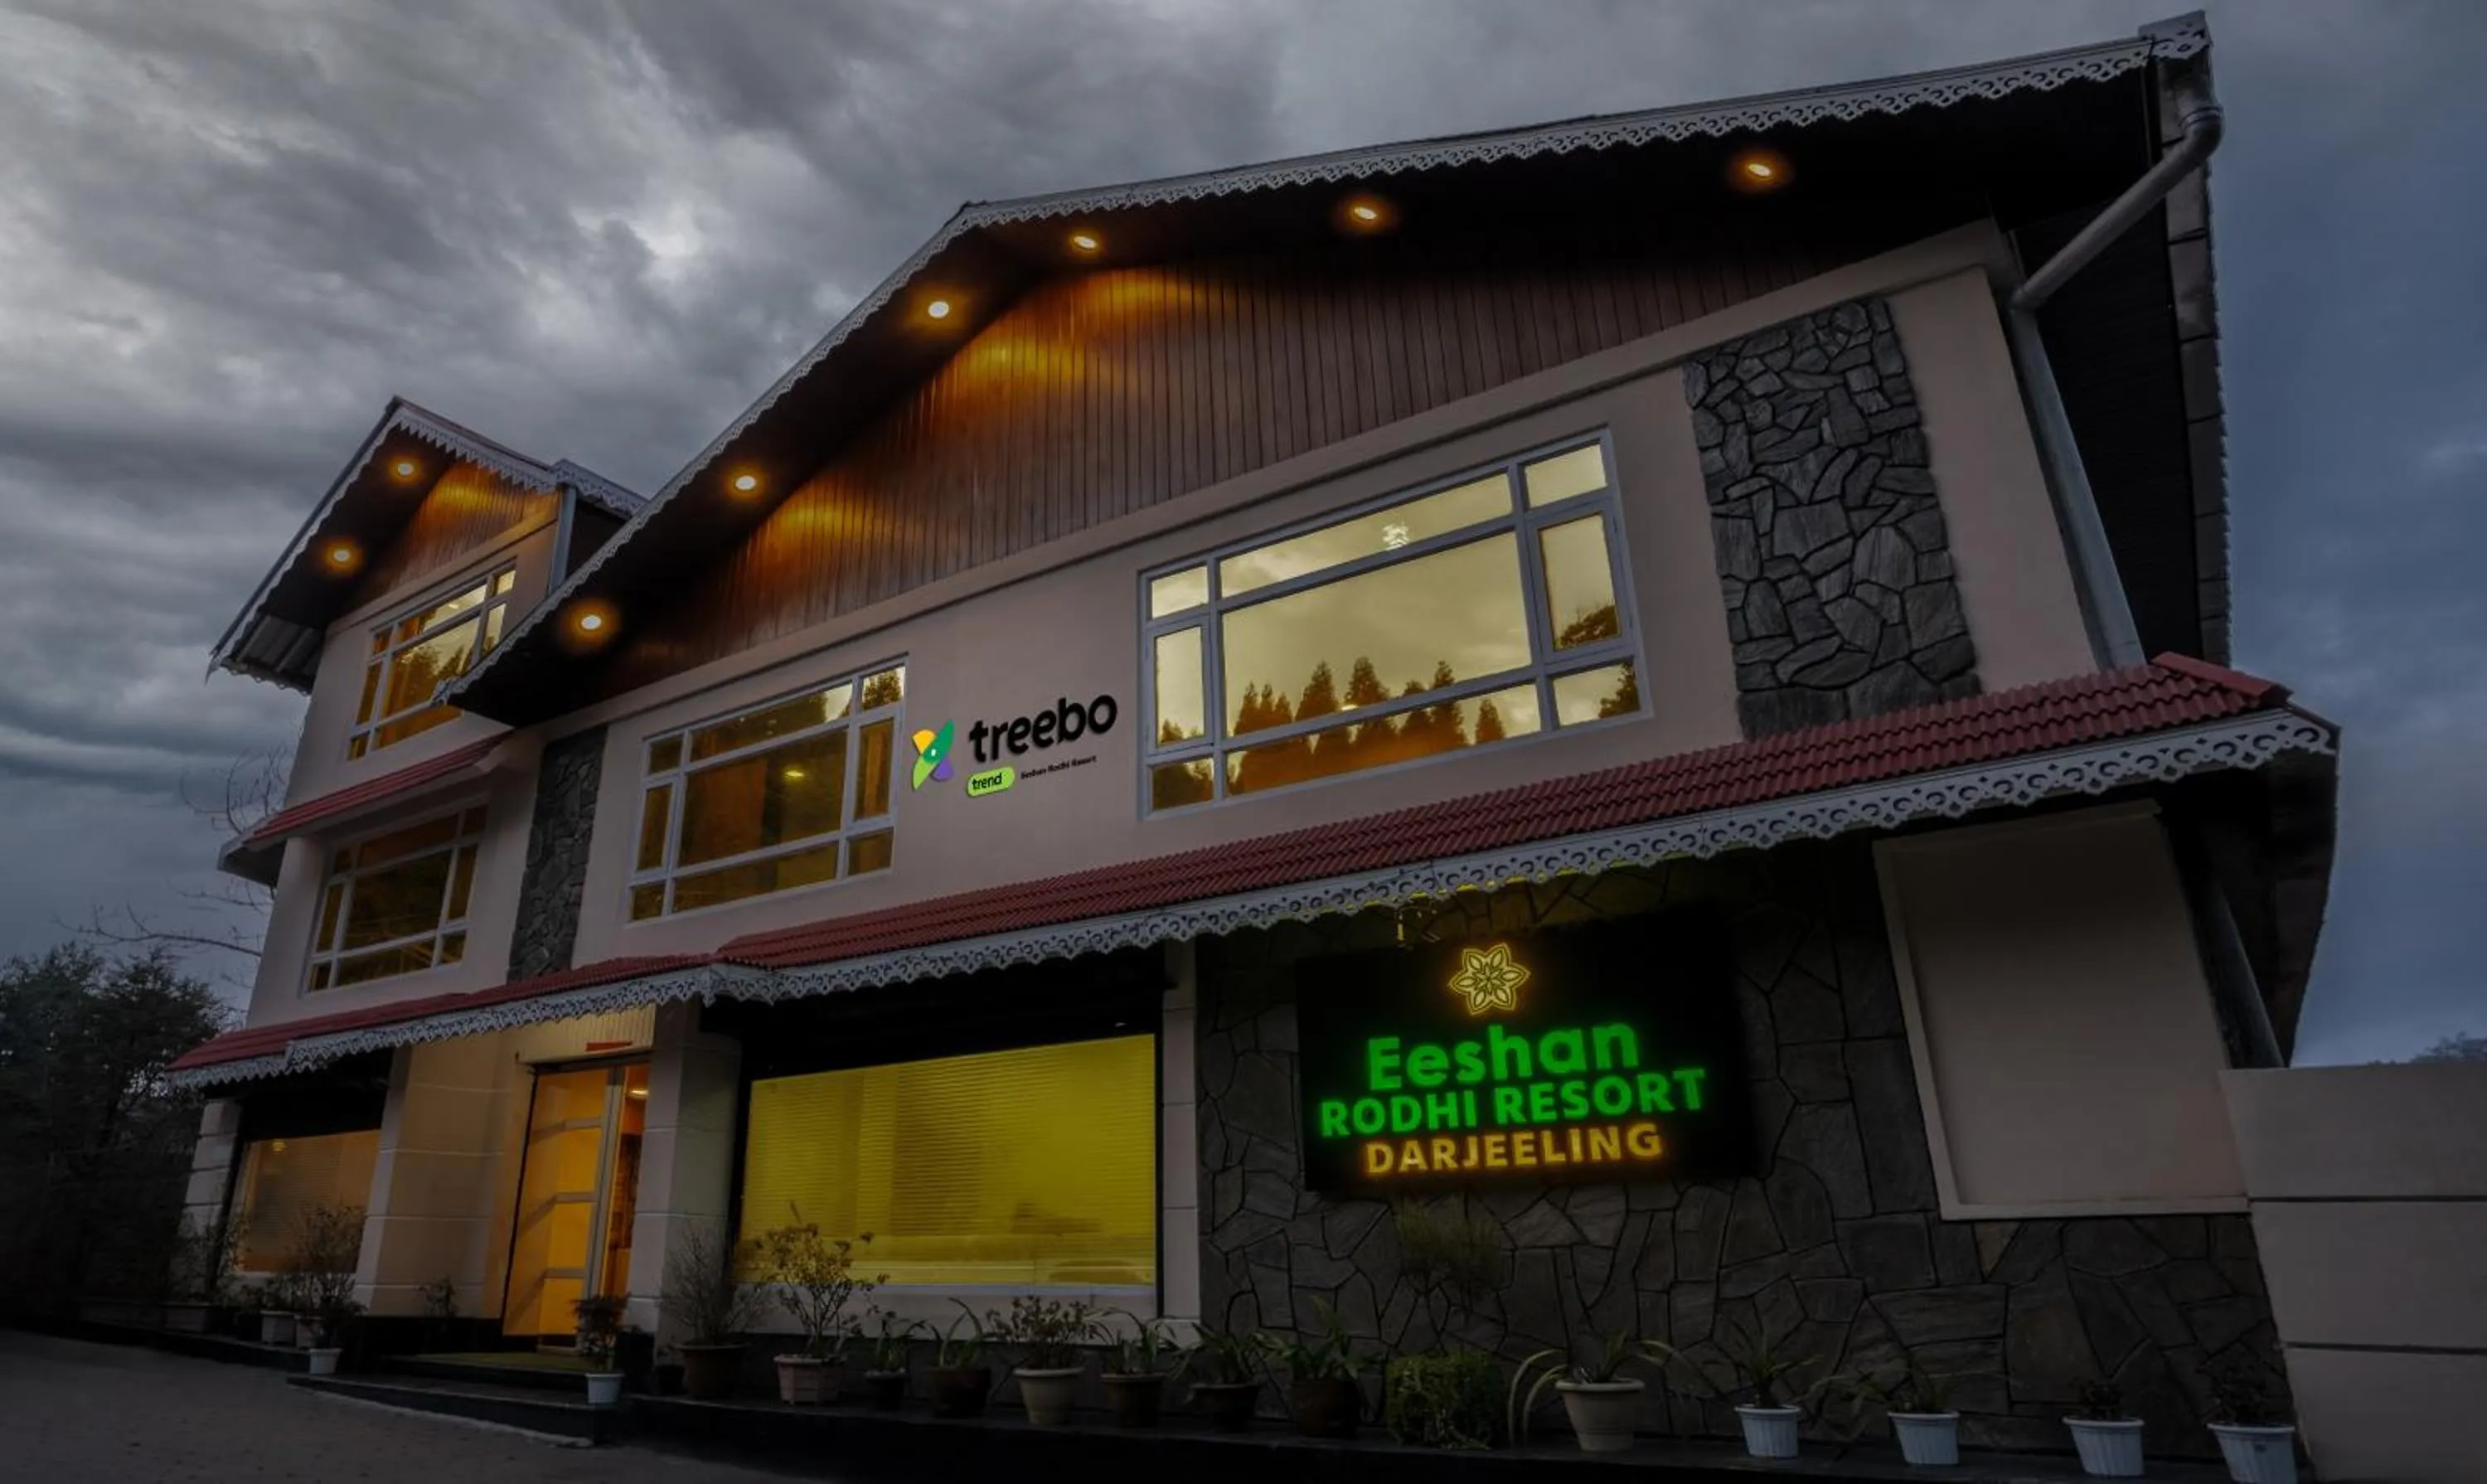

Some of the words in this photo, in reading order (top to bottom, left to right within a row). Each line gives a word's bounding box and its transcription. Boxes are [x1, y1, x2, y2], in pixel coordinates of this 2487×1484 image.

[969, 695, 1117, 763] treebo
[972, 773, 1003, 790] trend
[1367, 1021, 1641, 1092] Eeshan
[1321, 1090, 1477, 1137] RODHI
[1495, 1068, 1707, 1125] RESORT
[1365, 1122, 1663, 1174] DARJEELING
